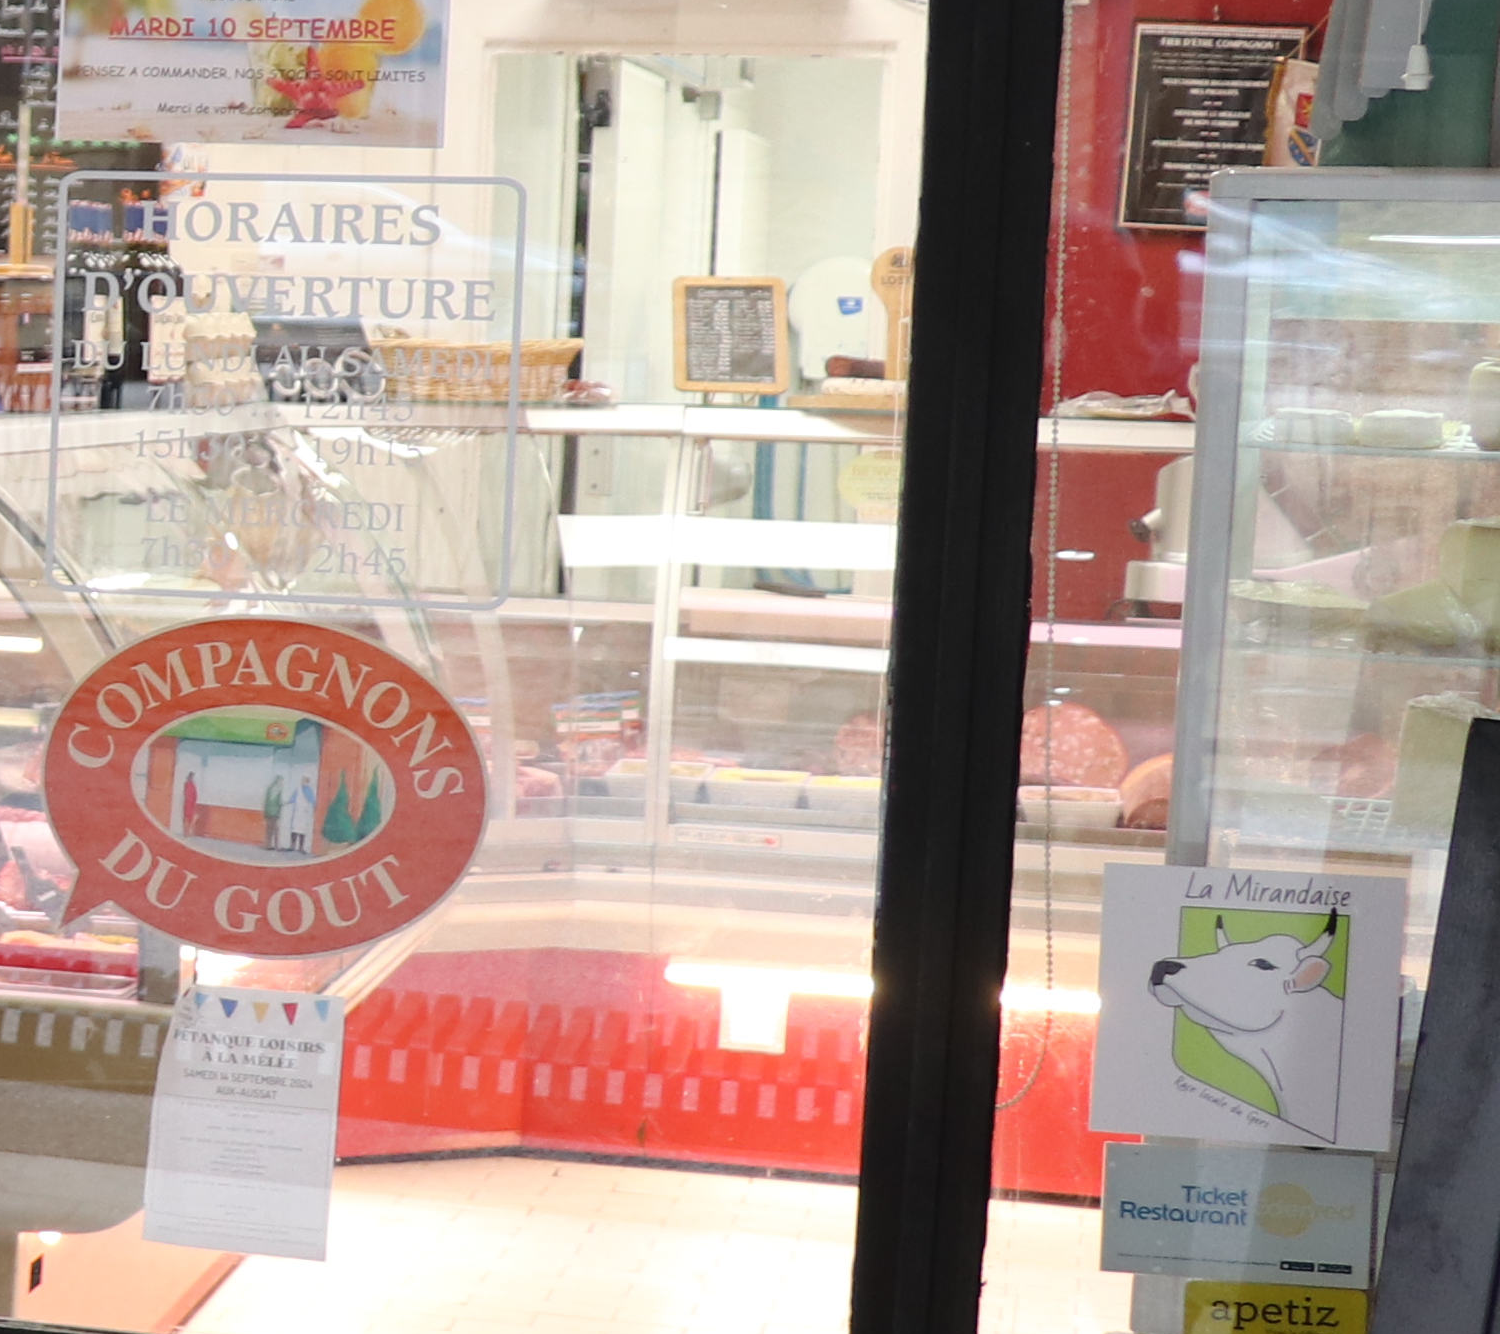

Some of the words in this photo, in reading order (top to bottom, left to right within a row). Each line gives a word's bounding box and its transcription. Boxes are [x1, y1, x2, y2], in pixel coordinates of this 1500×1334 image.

[108, 16, 196, 38] MARDI
[208, 17, 237, 38] 10
[246, 16, 396, 41] SEPTEMBRE
[128, 66, 138, 78] A
[234, 67, 264, 80] NOS
[268, 68, 322, 81] STOCKS
[325, 69, 364, 82] SONT
[366, 69, 426, 83] LIMITES
[156, 101, 192, 115] Merci
[196, 102, 209, 114] de
[141, 199, 442, 247] HORAIRES
[81, 270, 497, 323] D'OUVERTURE
[70, 339, 126, 371] DU
[140, 341, 258, 375] LUNDI
[272, 344, 326, 376] AU
[343, 346, 494, 381] SAMEDI
[145, 385, 238, 418] 7h30
[301, 389, 415, 422] 12h45
[312, 435, 424, 467] 19h15
[145, 495, 190, 524] LE
[211, 497, 405, 533] MERCREDI
[140, 535, 229, 567] 7h30
[66, 638, 466, 803] COMPAGNONS
[97, 827, 197, 911] DU
[212, 853, 417, 937] GOUT
[1184, 870, 1214, 900] La
[1224, 872, 1352, 908] Mirandaise
[173, 1027, 257, 1049] PÉTANQUE
[258, 1037, 326, 1055] LOISIRS
[201, 1048, 213, 1062] À
[217, 1052, 237, 1065] LA
[242, 1052, 298, 1070] MÊLÉE
[183, 1067, 219, 1079] SAMEDI
[231, 1072, 289, 1087] SEPTEMBRE
[289, 1077, 314, 1089] 2024
[1181, 1184, 1249, 1207] Ticket
[1118, 1199, 1248, 1226] Restaurant
[1209, 1296, 1341, 1331] apetiz
